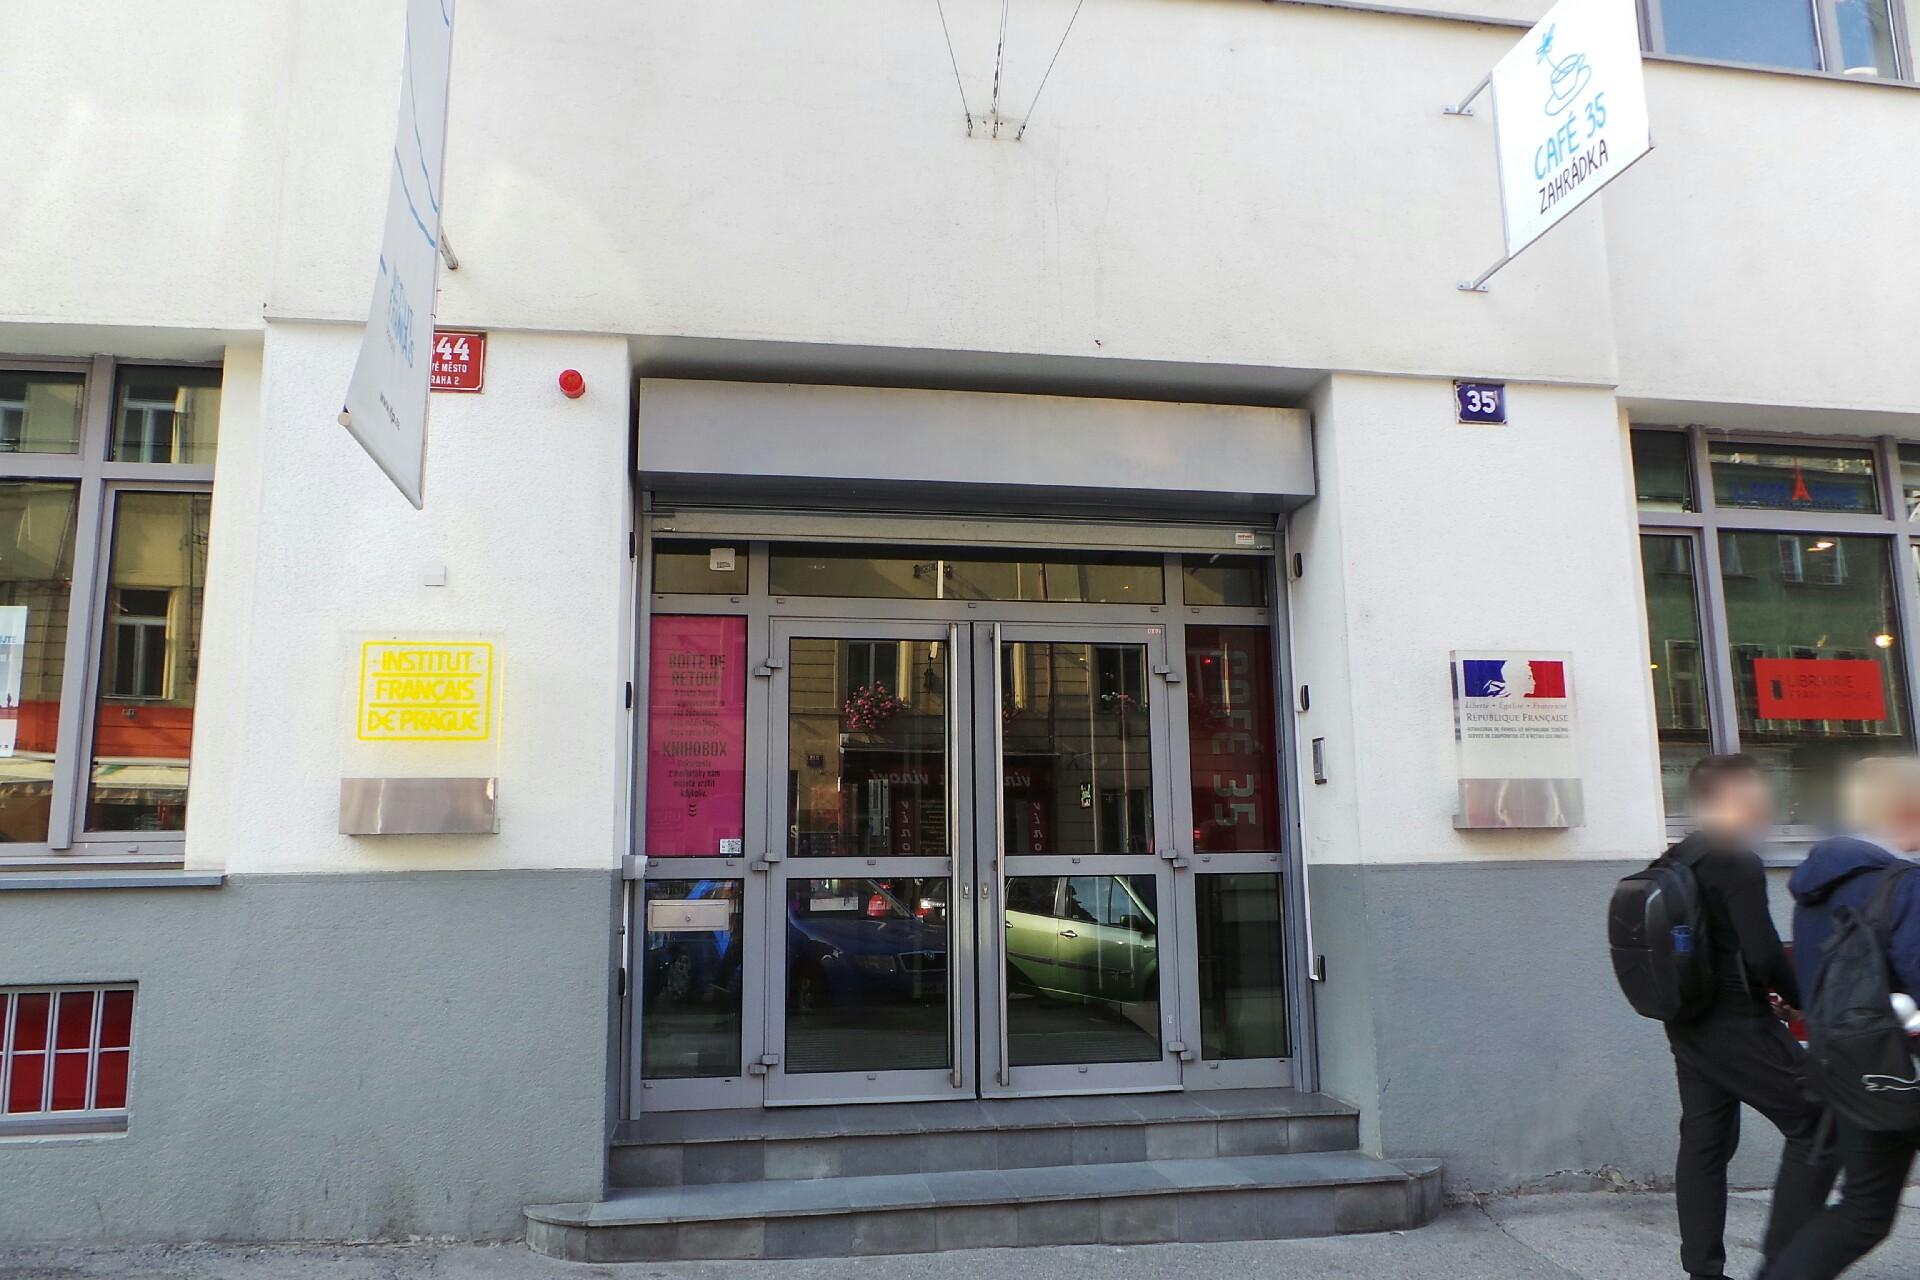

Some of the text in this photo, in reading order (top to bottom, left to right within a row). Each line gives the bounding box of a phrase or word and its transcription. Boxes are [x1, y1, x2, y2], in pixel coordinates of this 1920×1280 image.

[1534, 91, 1607, 181] CAFÉ 35
[1538, 138, 1609, 215] ZAHRÁDKA
[433, 336, 470, 361] 44
[441, 361, 468, 373] MĚSTO
[454, 376, 460, 385] 2
[1466, 390, 1496, 414] 35
[381, 650, 475, 672] INSTITUT
[375, 679, 476, 702] FRANÇAIS
[367, 709, 481, 732] DE PRAGUE
[1522, 712, 1569, 723] FRANÇAISE
[663, 740, 728, 758] KNIHOBOX
[1212, 773, 1257, 827] 35
